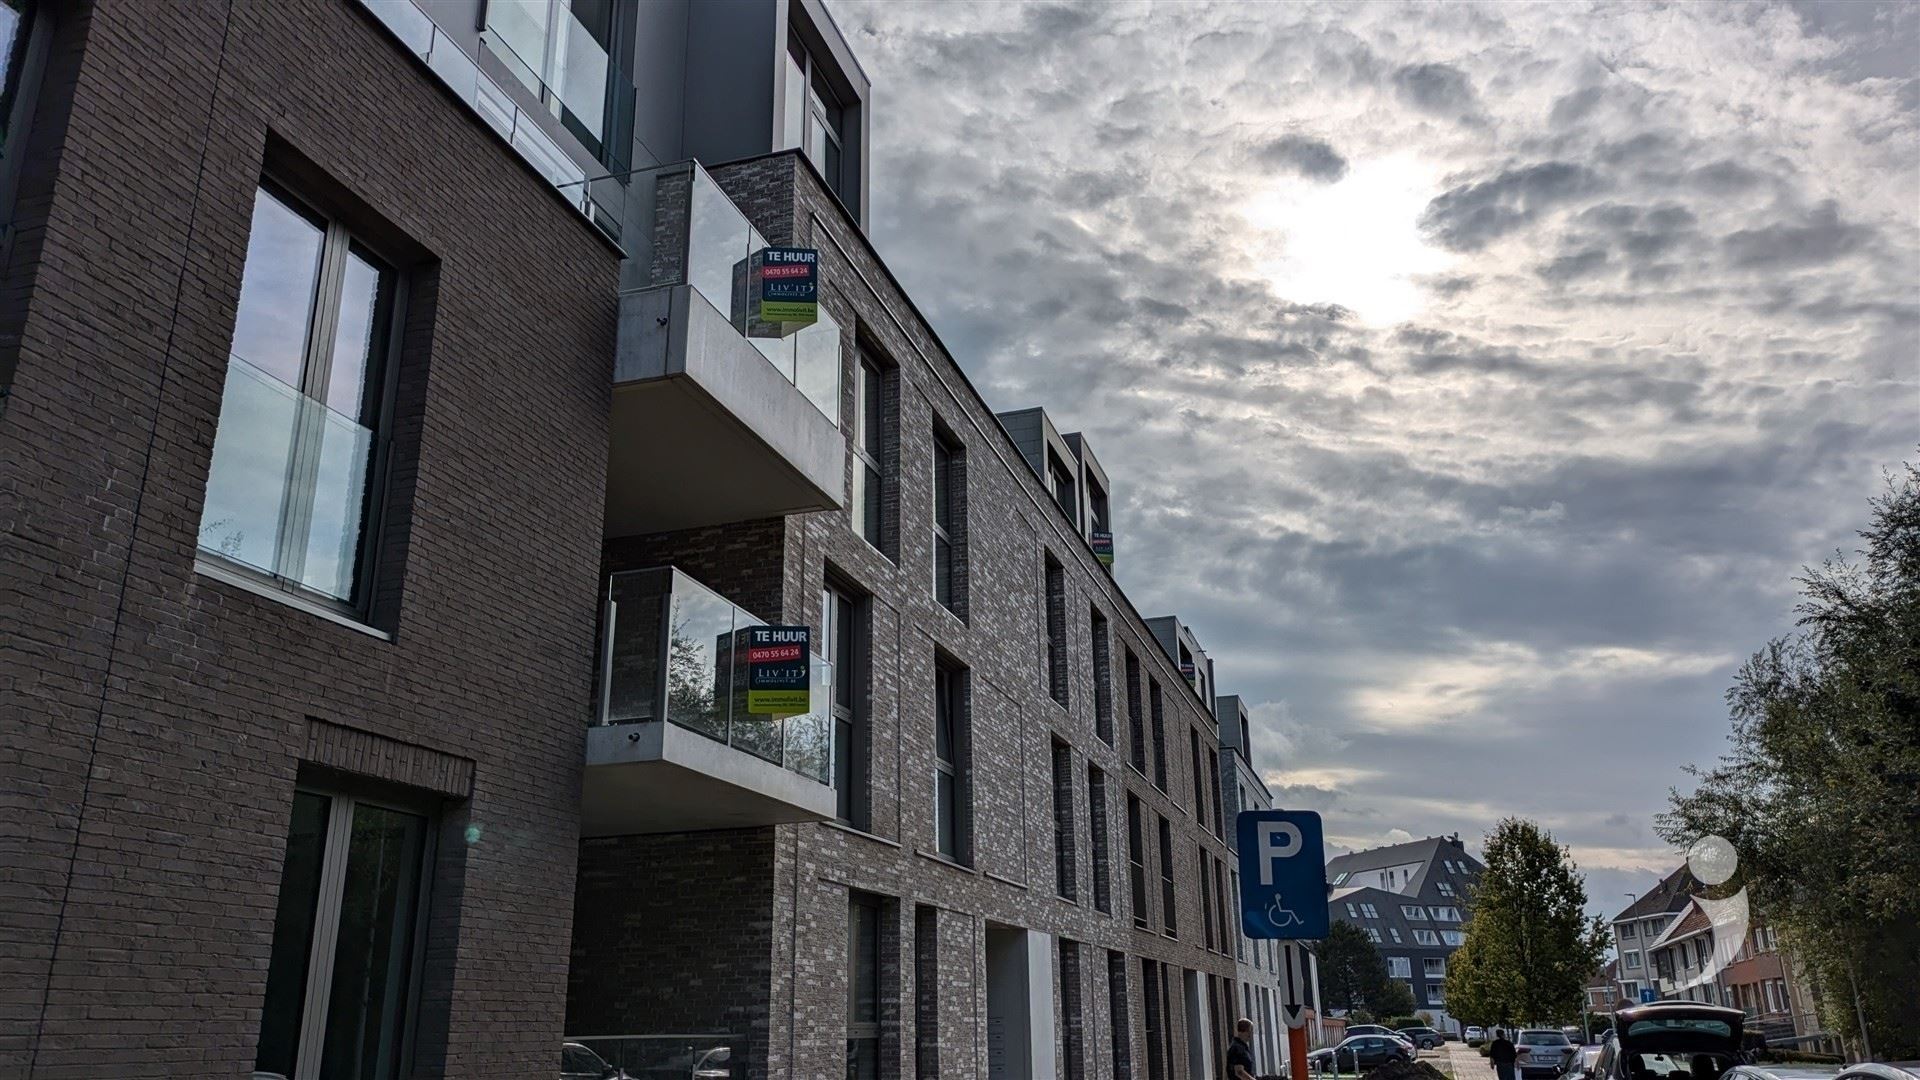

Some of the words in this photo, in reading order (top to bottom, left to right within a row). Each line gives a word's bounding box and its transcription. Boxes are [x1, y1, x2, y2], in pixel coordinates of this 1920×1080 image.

[767, 251, 781, 261] TE
[783, 252, 815, 262] HUUR
[755, 631, 770, 642] TE
[772, 631, 807, 642] HUUR
[752, 651, 769, 659] 0470
[770, 650, 779, 658] 55
[790, 648, 799, 656] 24
[1257, 821, 1303, 886] P
